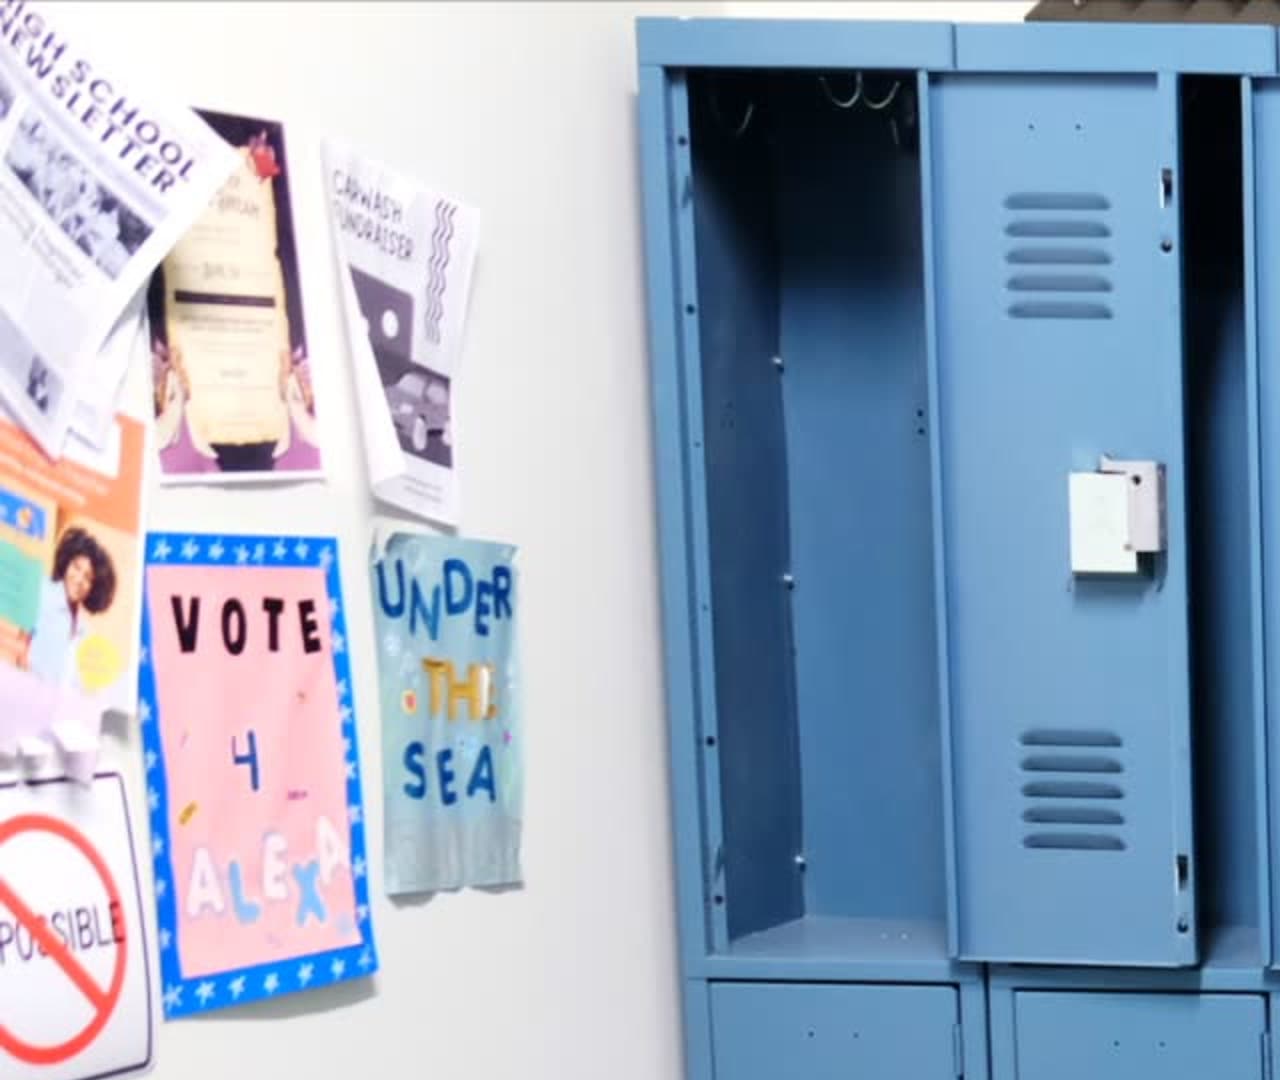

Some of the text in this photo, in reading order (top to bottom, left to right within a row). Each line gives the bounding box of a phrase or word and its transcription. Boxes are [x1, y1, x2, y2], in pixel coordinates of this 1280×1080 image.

[6, 0, 194, 182] IGH SCHOOL
[334, 169, 402, 223] CARWASH
[333, 200, 414, 260] FUNDRAISER
[170, 595, 322, 656] VOTE
[377, 558, 513, 641] UNDER
[231, 729, 259, 791] 4
[403, 741, 497, 806] SEA
[187, 815, 346, 925] ALEXA
